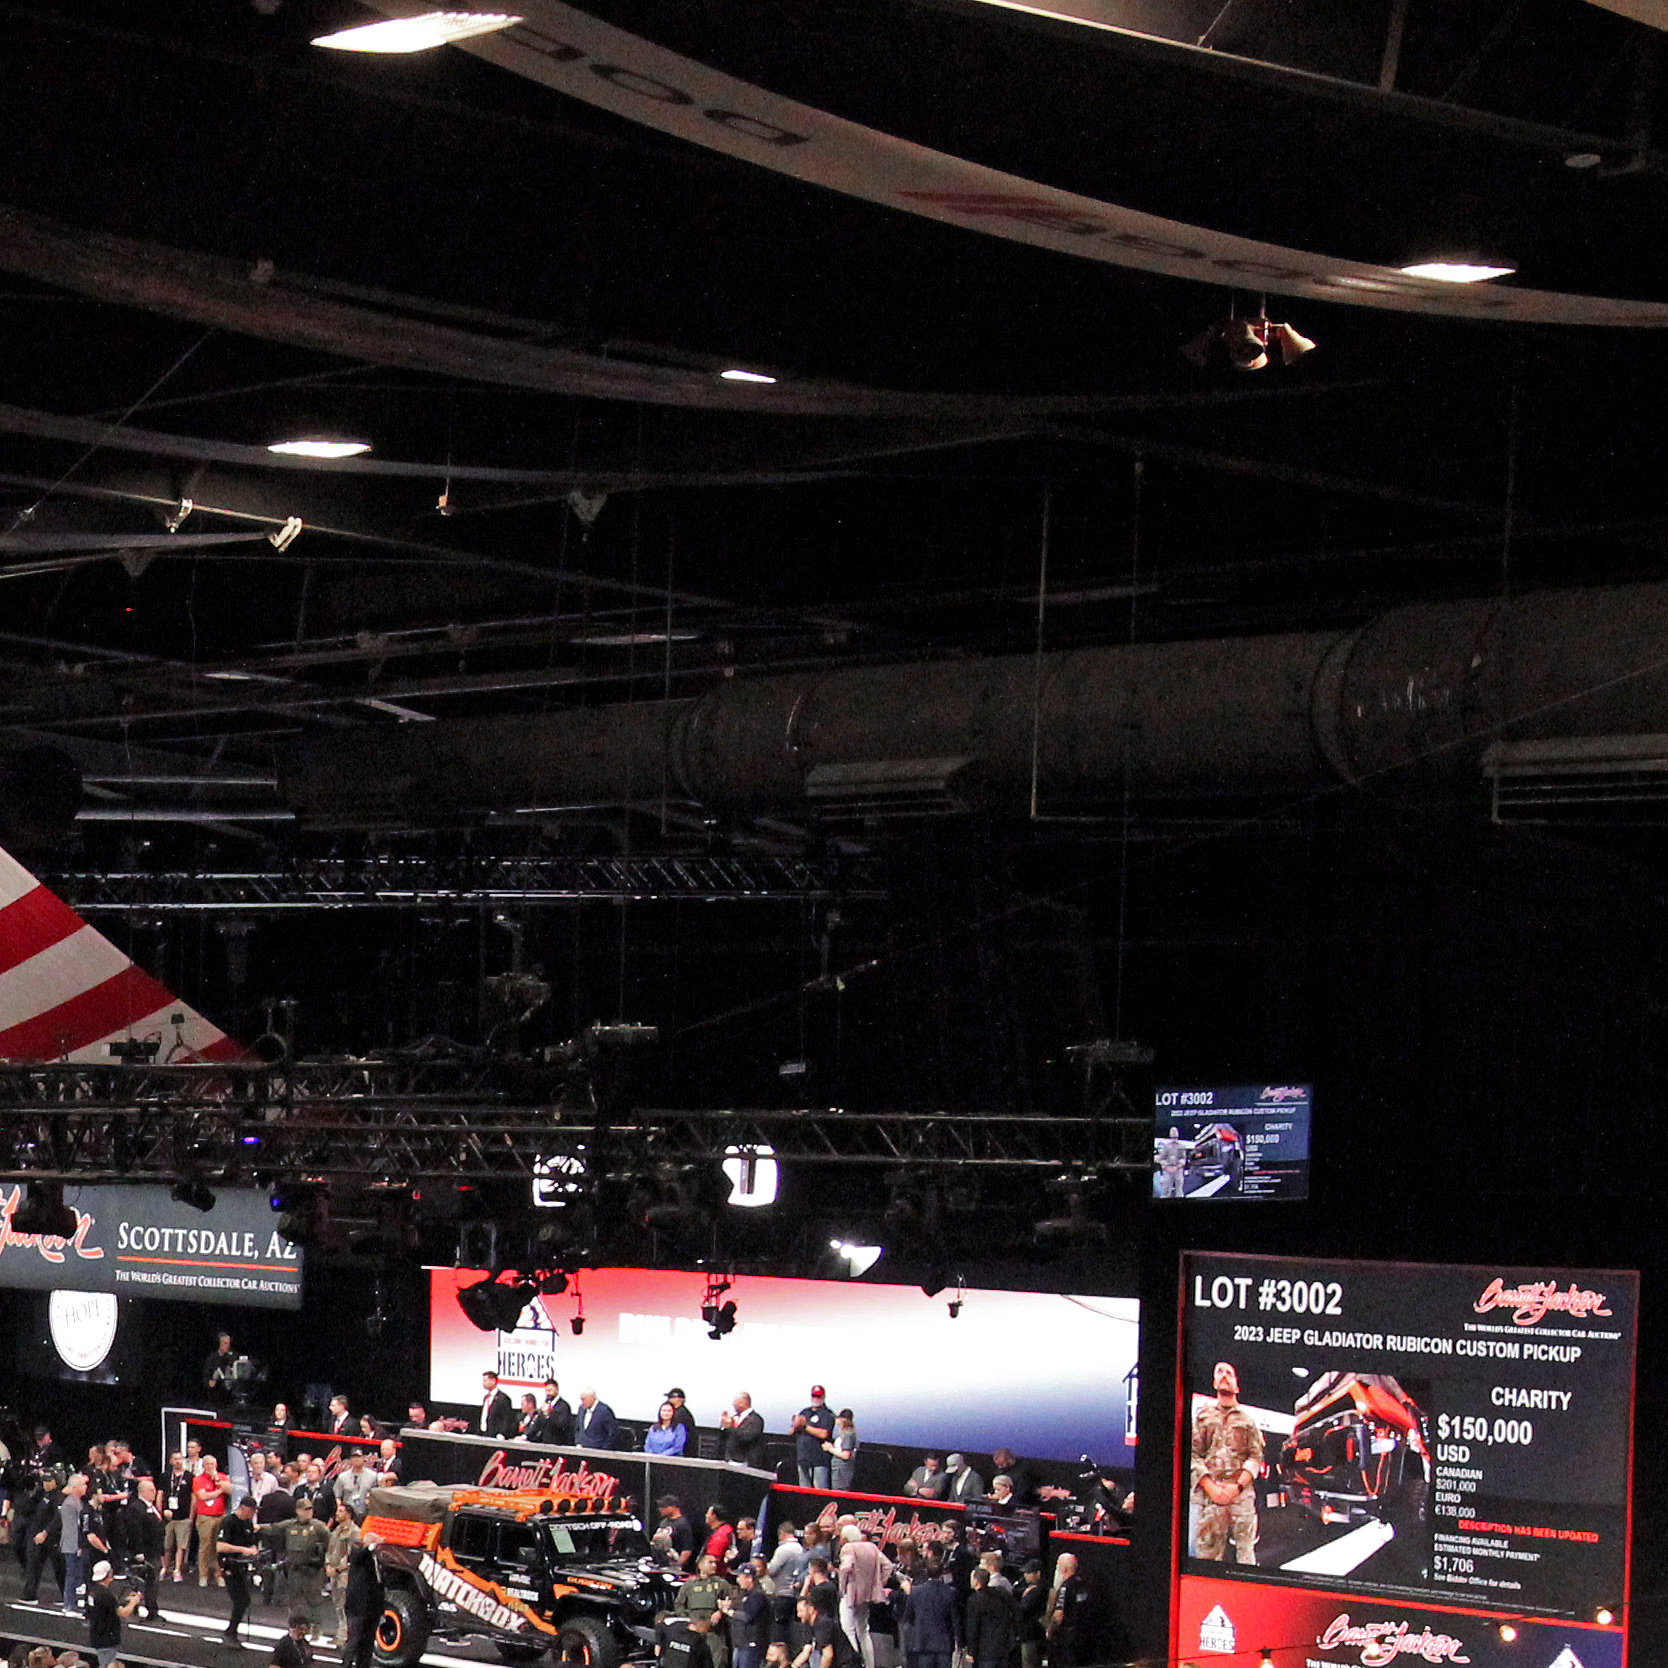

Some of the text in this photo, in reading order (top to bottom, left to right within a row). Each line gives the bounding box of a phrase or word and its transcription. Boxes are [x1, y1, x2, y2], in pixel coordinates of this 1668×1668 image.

[1156, 1092, 1214, 1106] LOT #3002
[1194, 1275, 1343, 1316] LOT #3002
[1234, 1325, 1582, 1363] 2023 JEEP GLADIATOR RUBICON CUSTOM PICKUP
[1491, 1386, 1572, 1411] CHARITY
[1437, 1413, 1533, 1446] $150,000
[1437, 1444, 1470, 1463] USD
[1436, 1466, 1483, 1480] CANADIAN
[1435, 1492, 1461, 1503] EURO
[1434, 1555, 1475, 1573] $1,706
[418, 1552, 528, 1634] MATCHBOX
[669, 1641, 691, 1653] POLICE
